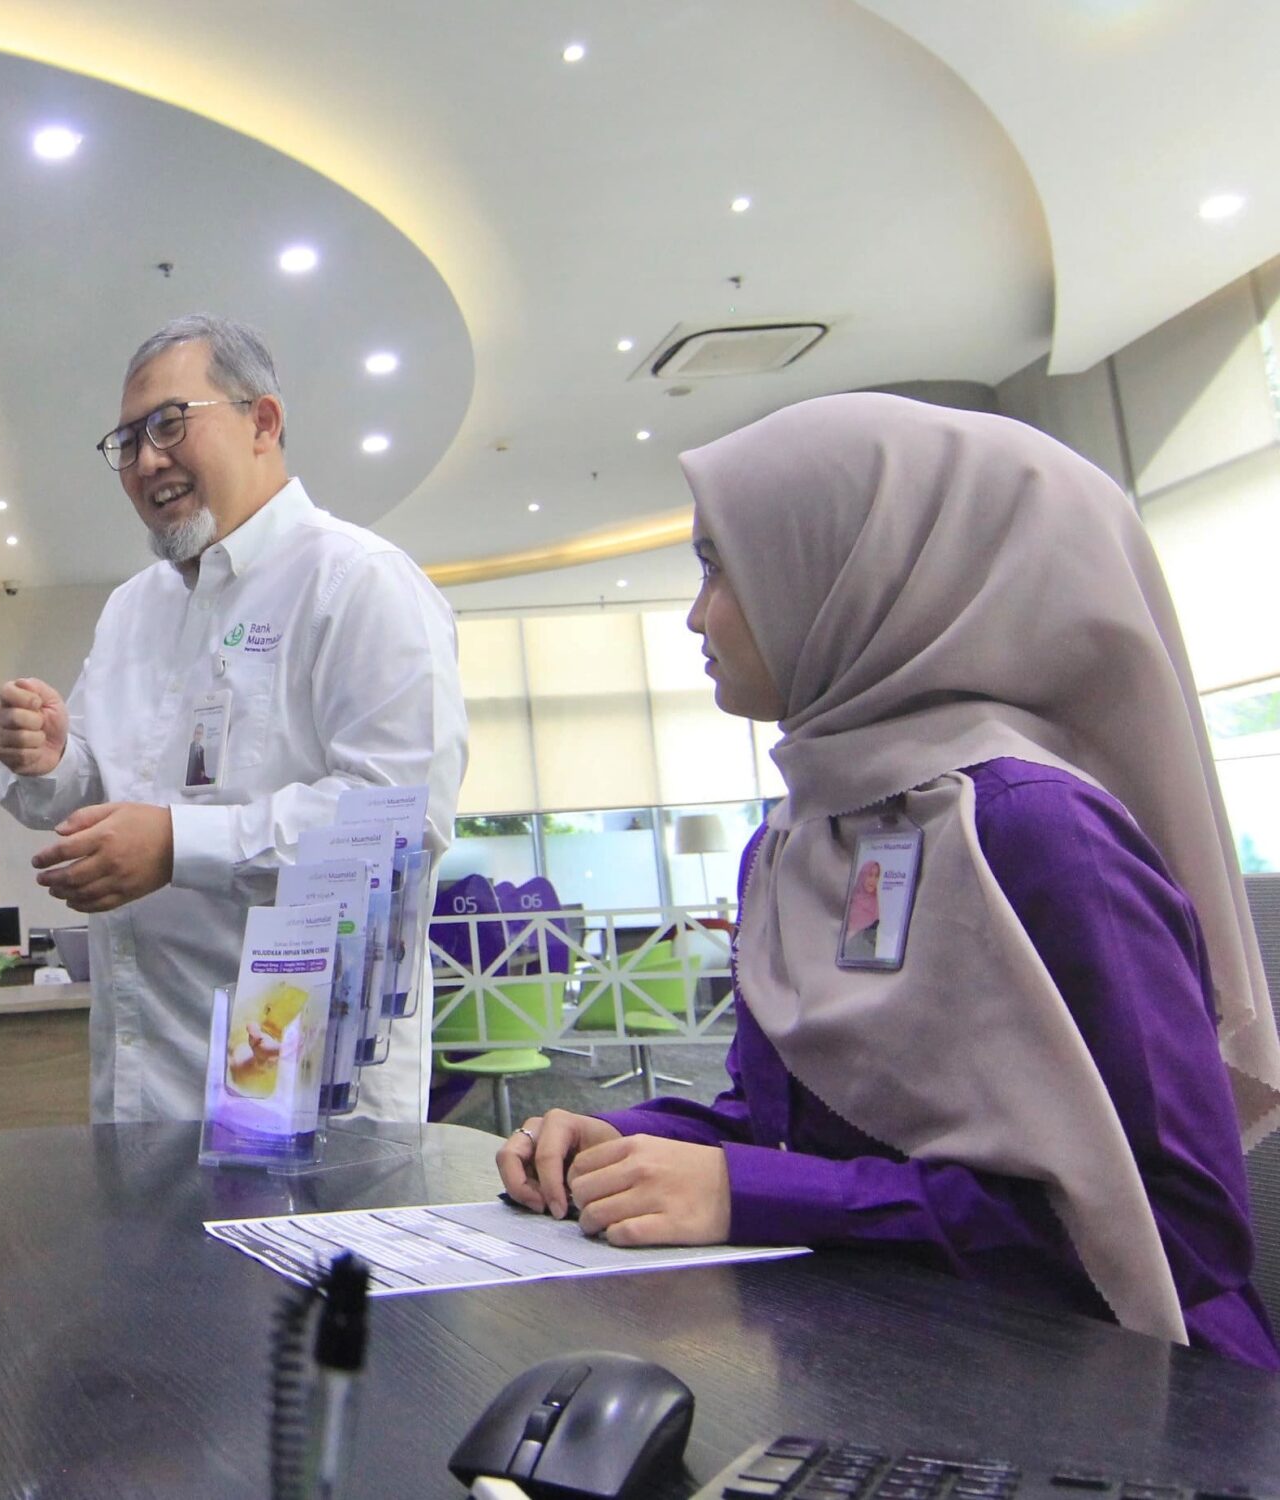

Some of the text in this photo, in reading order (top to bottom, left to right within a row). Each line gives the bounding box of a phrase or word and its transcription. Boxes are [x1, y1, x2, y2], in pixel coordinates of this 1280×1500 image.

[249, 622, 272, 634] Bank
[454, 896, 477, 914] 05
[521, 894, 542, 909] 06
